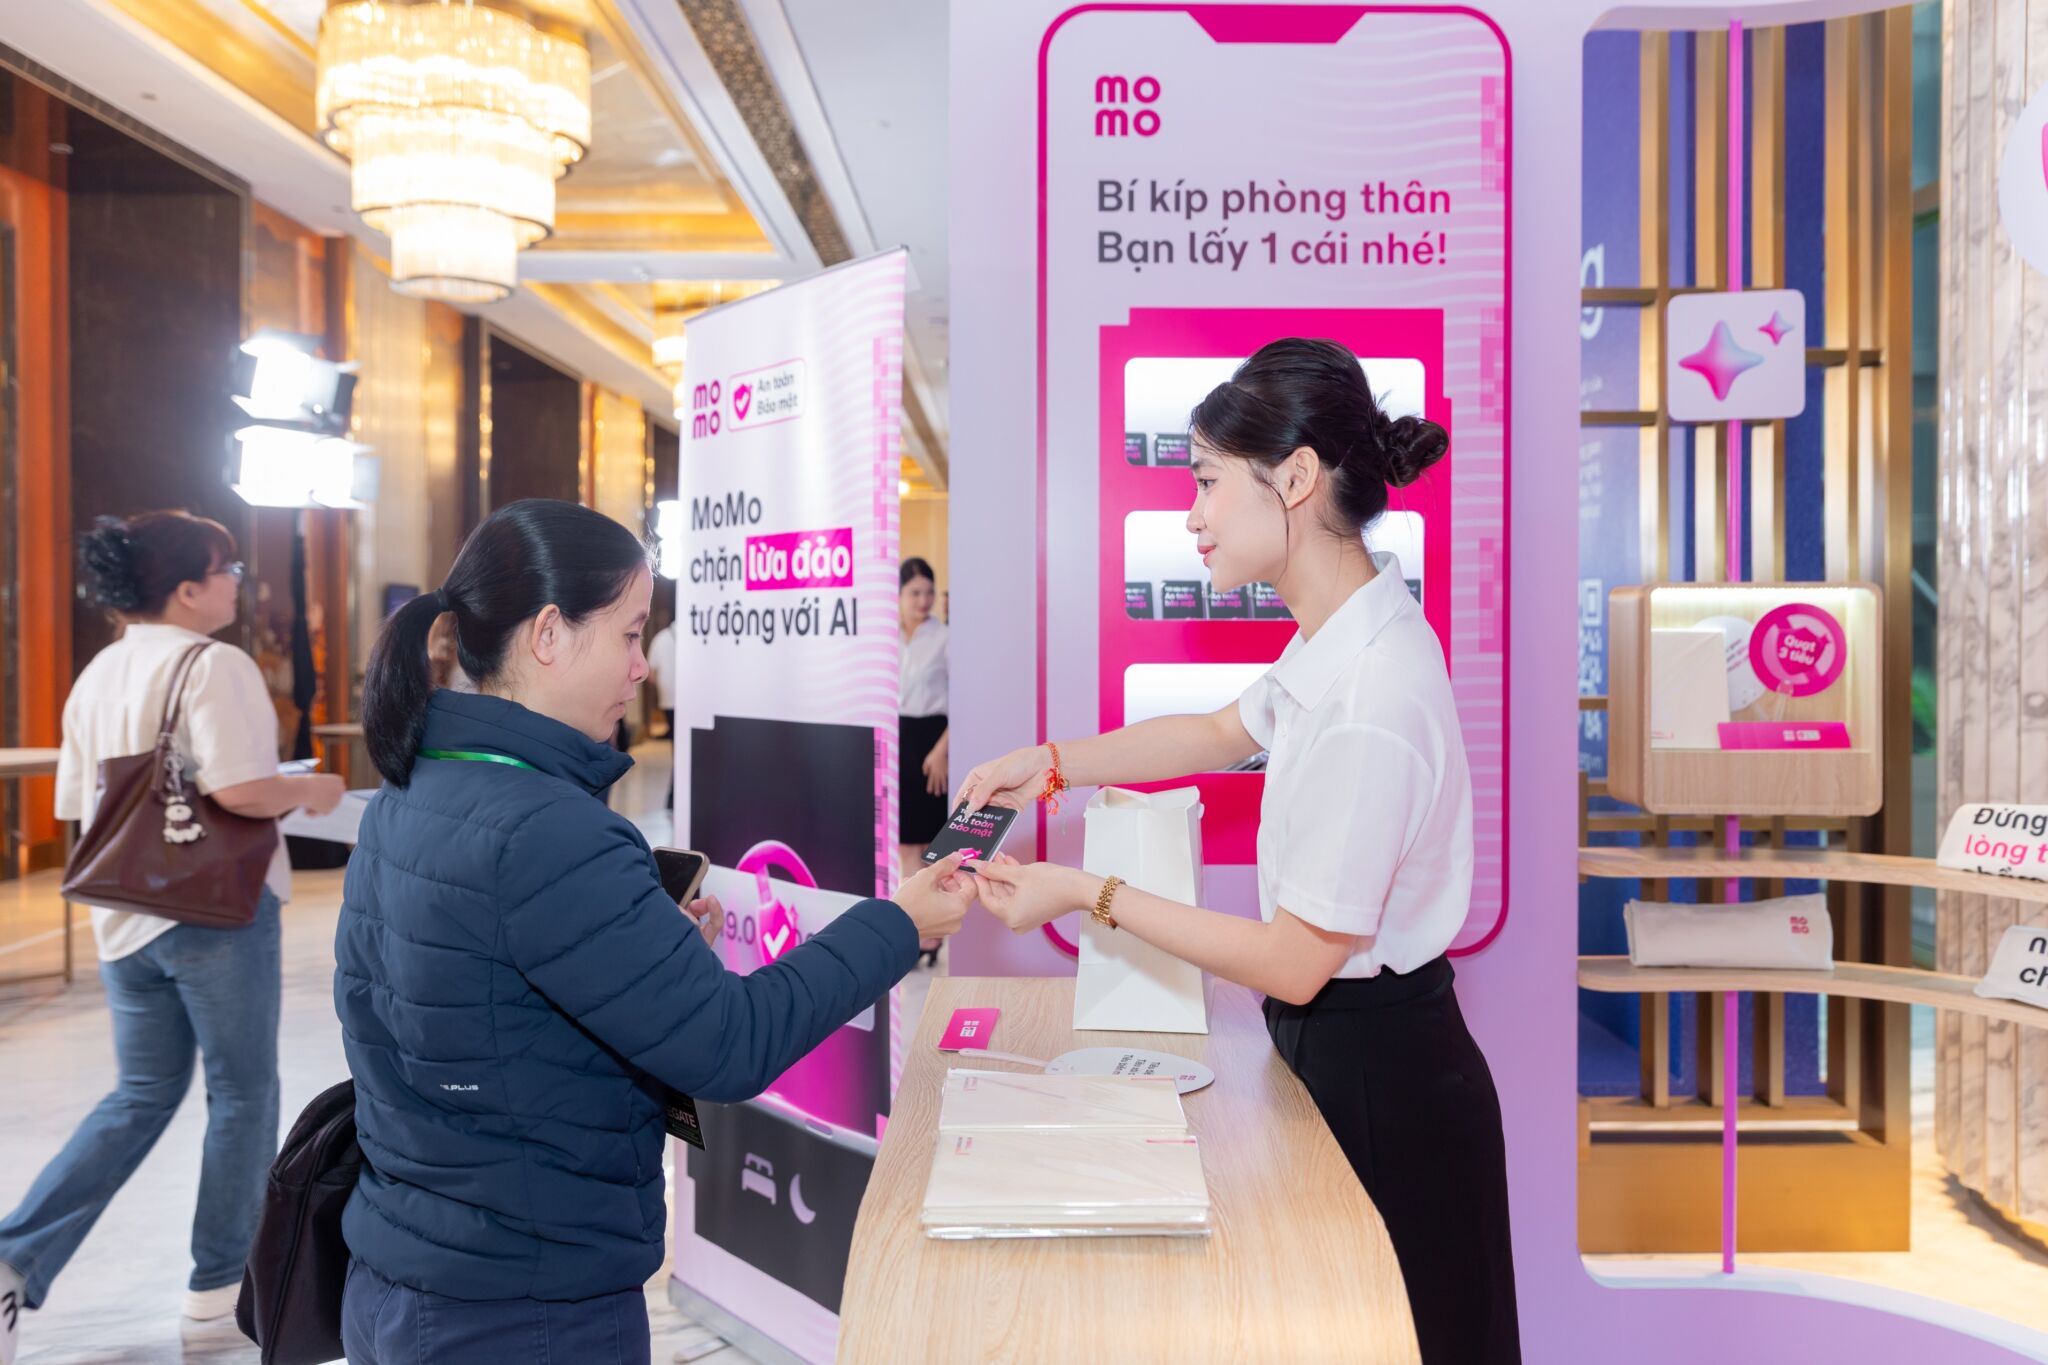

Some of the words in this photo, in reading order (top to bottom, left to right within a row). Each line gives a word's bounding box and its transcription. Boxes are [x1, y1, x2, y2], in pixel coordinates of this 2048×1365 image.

[1098, 178, 1139, 212] Bí
[1150, 178, 1208, 220] kíp
[1222, 178, 1346, 221] phòng
[1360, 179, 1450, 213] thân
[1098, 231, 1174, 273] Bạn
[1189, 226, 1249, 272] lấy
[1261, 232, 1276, 264] 1
[1291, 231, 1348, 264] cái
[1362, 231, 1446, 265] nhé!
[692, 490, 762, 531] MoMo
[690, 547, 741, 591] chặn
[749, 542, 788, 582] lừa
[792, 535, 851, 579] đảo
[690, 604, 713, 645] tự
[717, 600, 775, 645] động
[782, 597, 820, 636] với
[829, 597, 858, 636] AI
[1965, 834, 2028, 865] lòng
